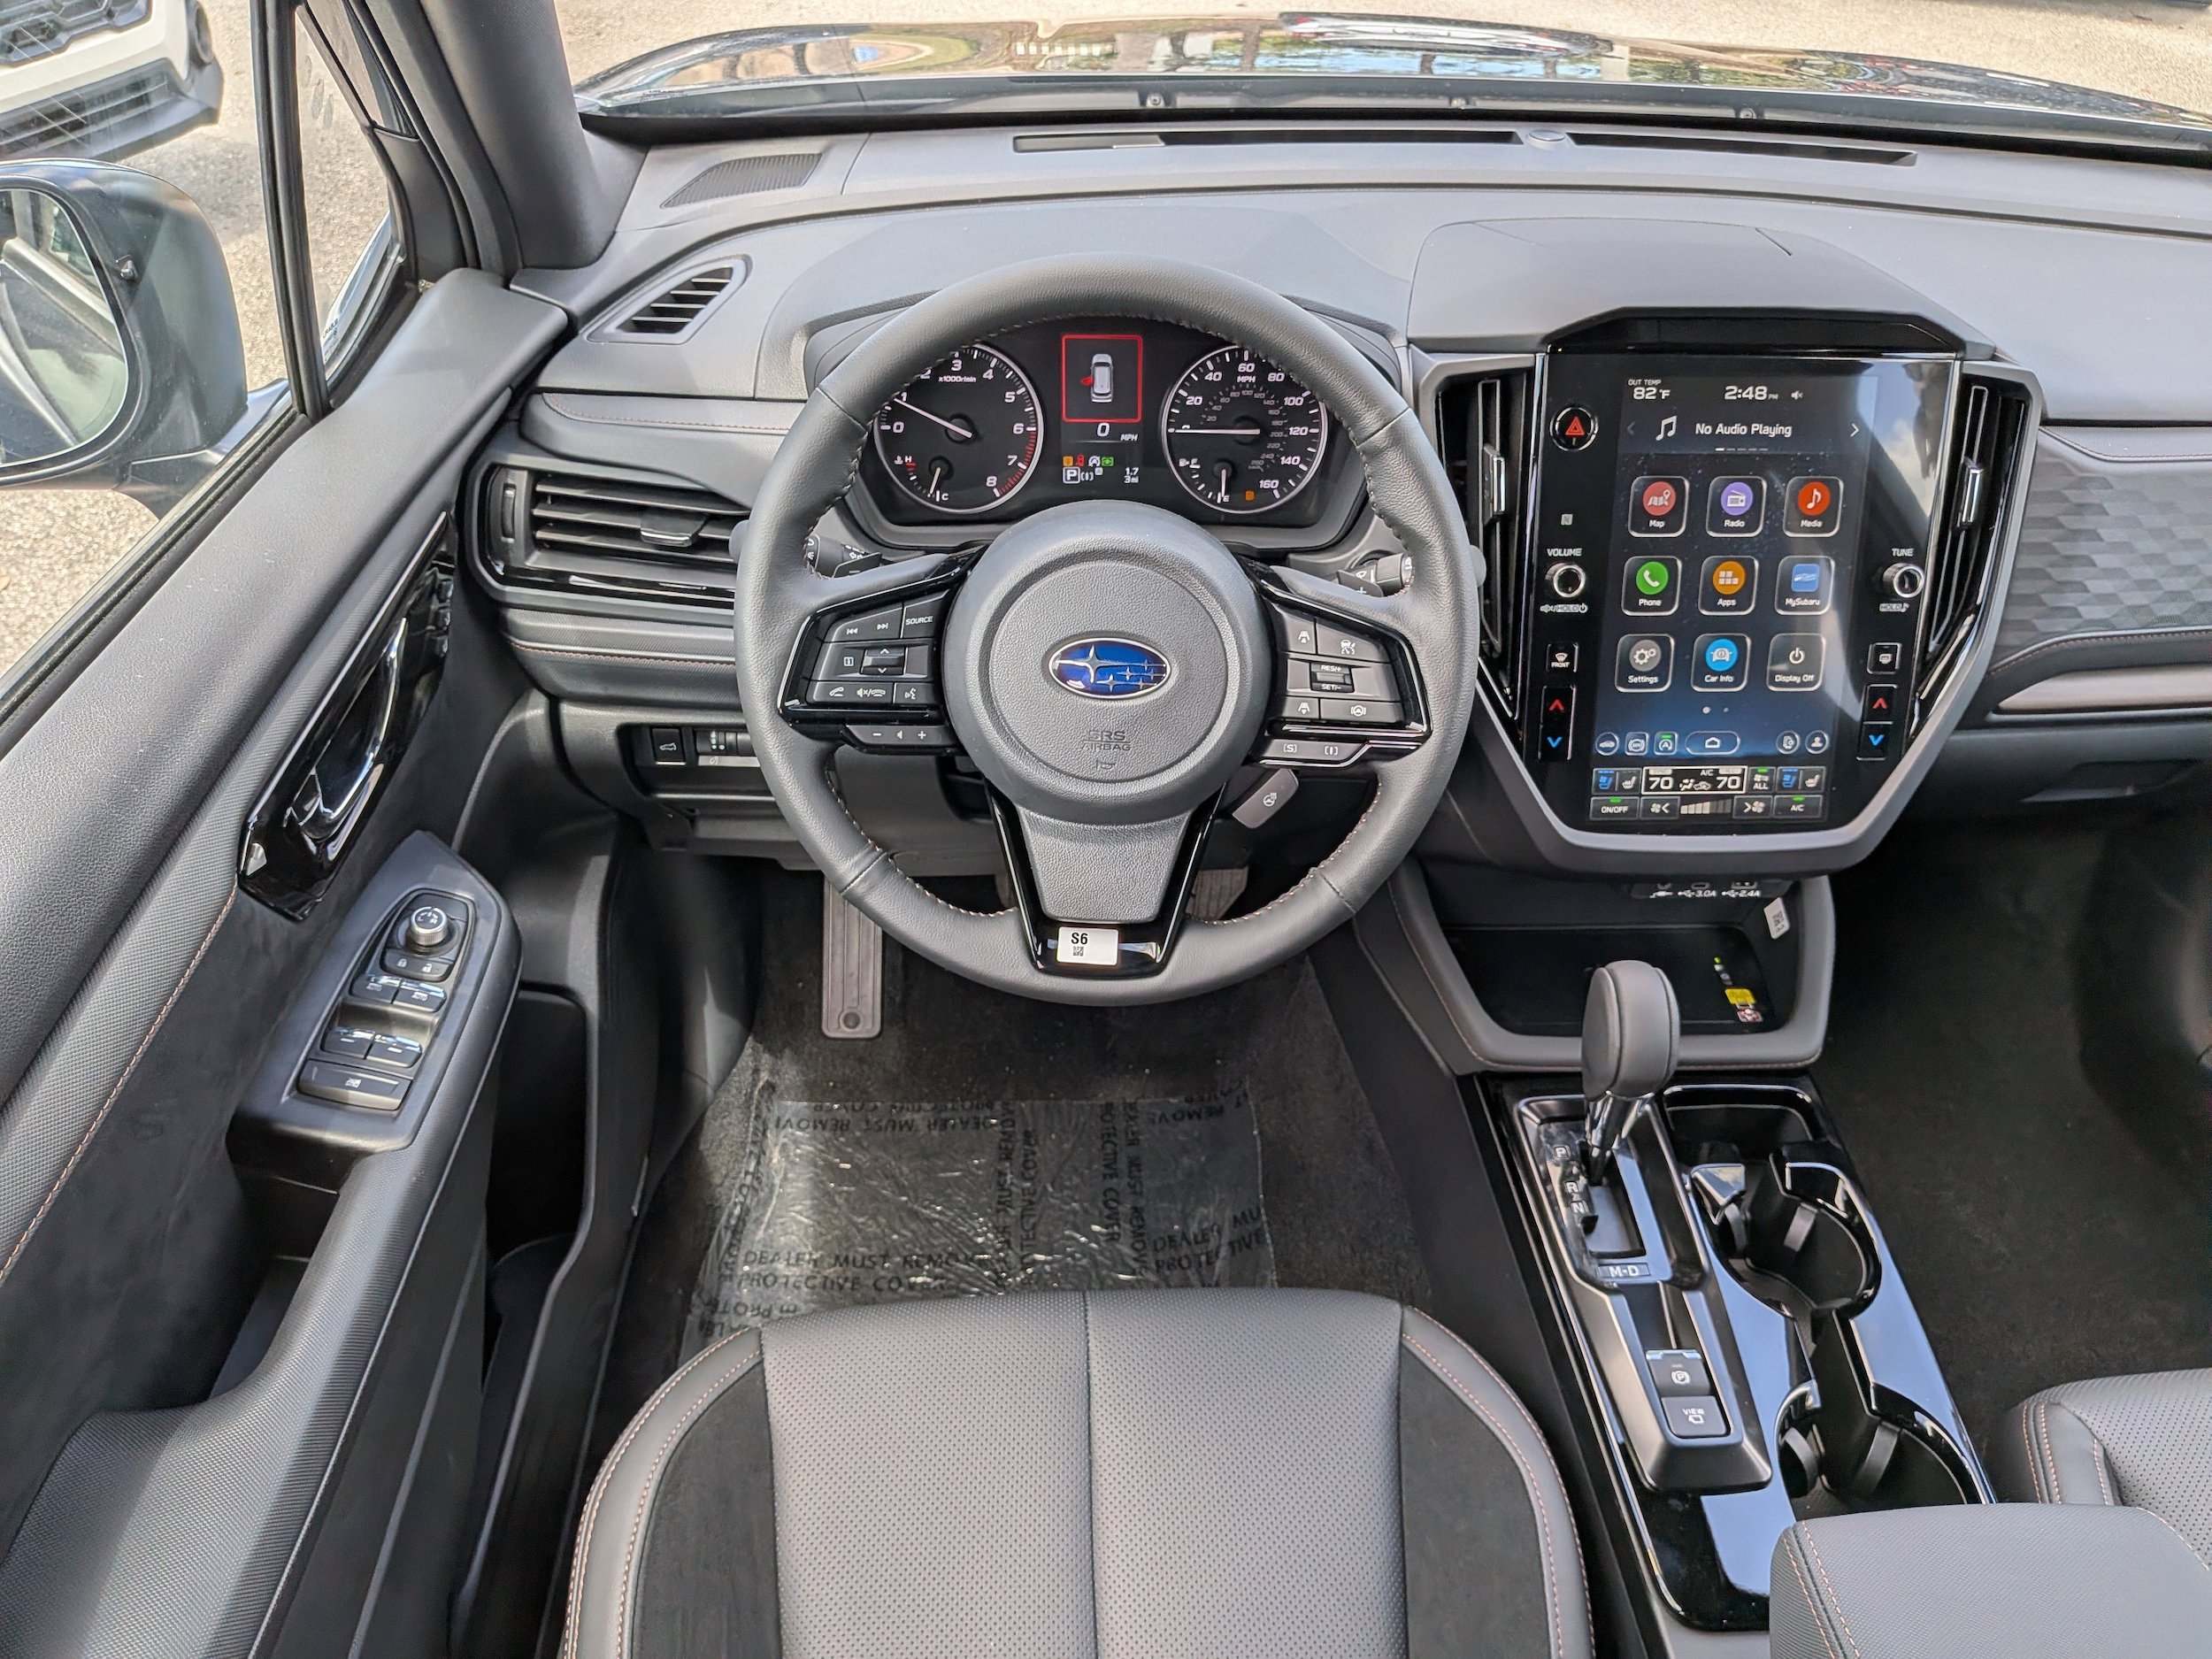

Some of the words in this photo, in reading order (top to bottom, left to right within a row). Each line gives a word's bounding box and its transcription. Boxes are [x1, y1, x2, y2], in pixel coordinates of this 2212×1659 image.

[951, 360, 963, 371] 3
[1238, 363, 1255, 372] 60
[982, 370, 994, 380] 4
[1204, 372, 1223, 381] 40
[1237, 375, 1256, 384] MPH
[1267, 373, 1286, 382] 80
[1004, 392, 1016, 403] 5
[1724, 386, 1768, 401] 2:48
[1186, 396, 1203, 405] 20
[1283, 396, 1304, 406] 100
[892, 421, 904, 434] 0
[1012, 423, 1025, 434] 6
[1097, 423, 1110, 437] 0
[1288, 426, 1309, 435] 120
[1695, 424, 1712, 435] No
[1715, 423, 1747, 435] Audio
[1751, 423, 1793, 438] Playing
[1007, 455, 1018, 465] 7
[1279, 457, 1301, 465] 140
[1125, 467, 1140, 476] 1.7
[986, 476, 997, 487] 8
[1259, 480, 1279, 488] 160
[1649, 519, 1665, 529] Map
[1724, 518, 1745, 527] Radio
[1801, 518, 1822, 527] Media
[1547, 549, 1583, 557] VOLUME
[1892, 548, 1914, 557] TUNE
[1639, 598, 1662, 607] Phone
[1717, 598, 1736, 607] Apps
[1786, 598, 1820, 607] MySubaru
[905, 616, 934, 626] SOURCE
[1628, 675, 1658, 684] Settings
[1775, 674, 1798, 683] Display
[1088, 731, 1125, 741] SRS
[1081, 743, 1131, 752] AIRBAG
[1648, 777, 1674, 789] 70
[1717, 776, 1741, 789] 70
[1601, 805, 1629, 814] ON/OFF
[1071, 933, 1088, 945] S6
[864, 1118, 915, 1133] MUST
[1555, 1147, 1568, 1157] P
[1566, 1182, 1578, 1193] R
[1571, 1202, 1587, 1213] N
[743, 1249, 818, 1269] DEALER
[832, 1253, 890, 1270] MUST
